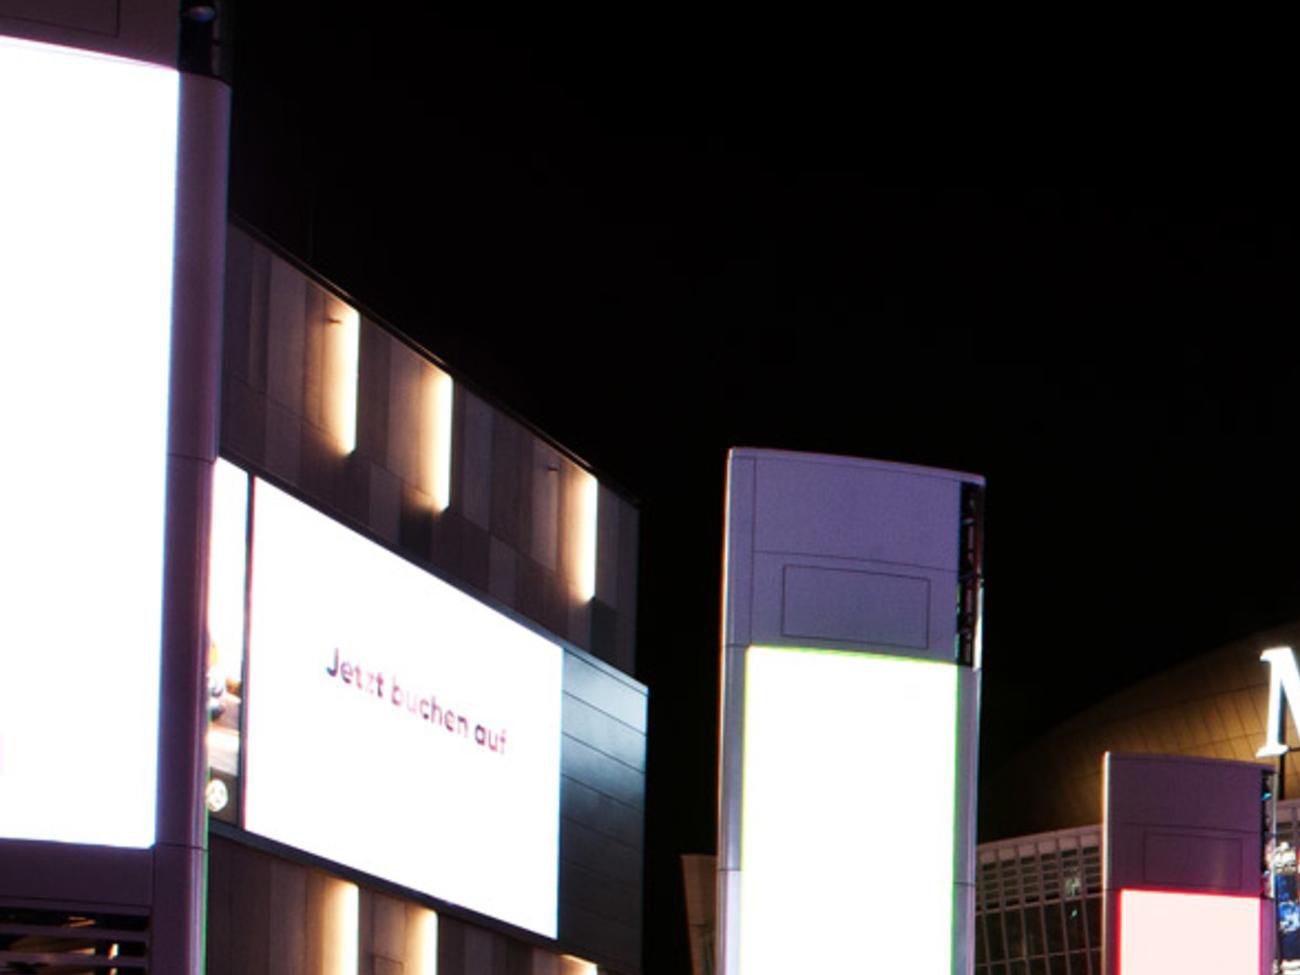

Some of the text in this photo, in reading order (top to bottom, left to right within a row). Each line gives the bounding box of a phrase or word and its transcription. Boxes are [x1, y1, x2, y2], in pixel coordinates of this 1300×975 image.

[325, 646, 508, 755] Jetzt buchen auf
